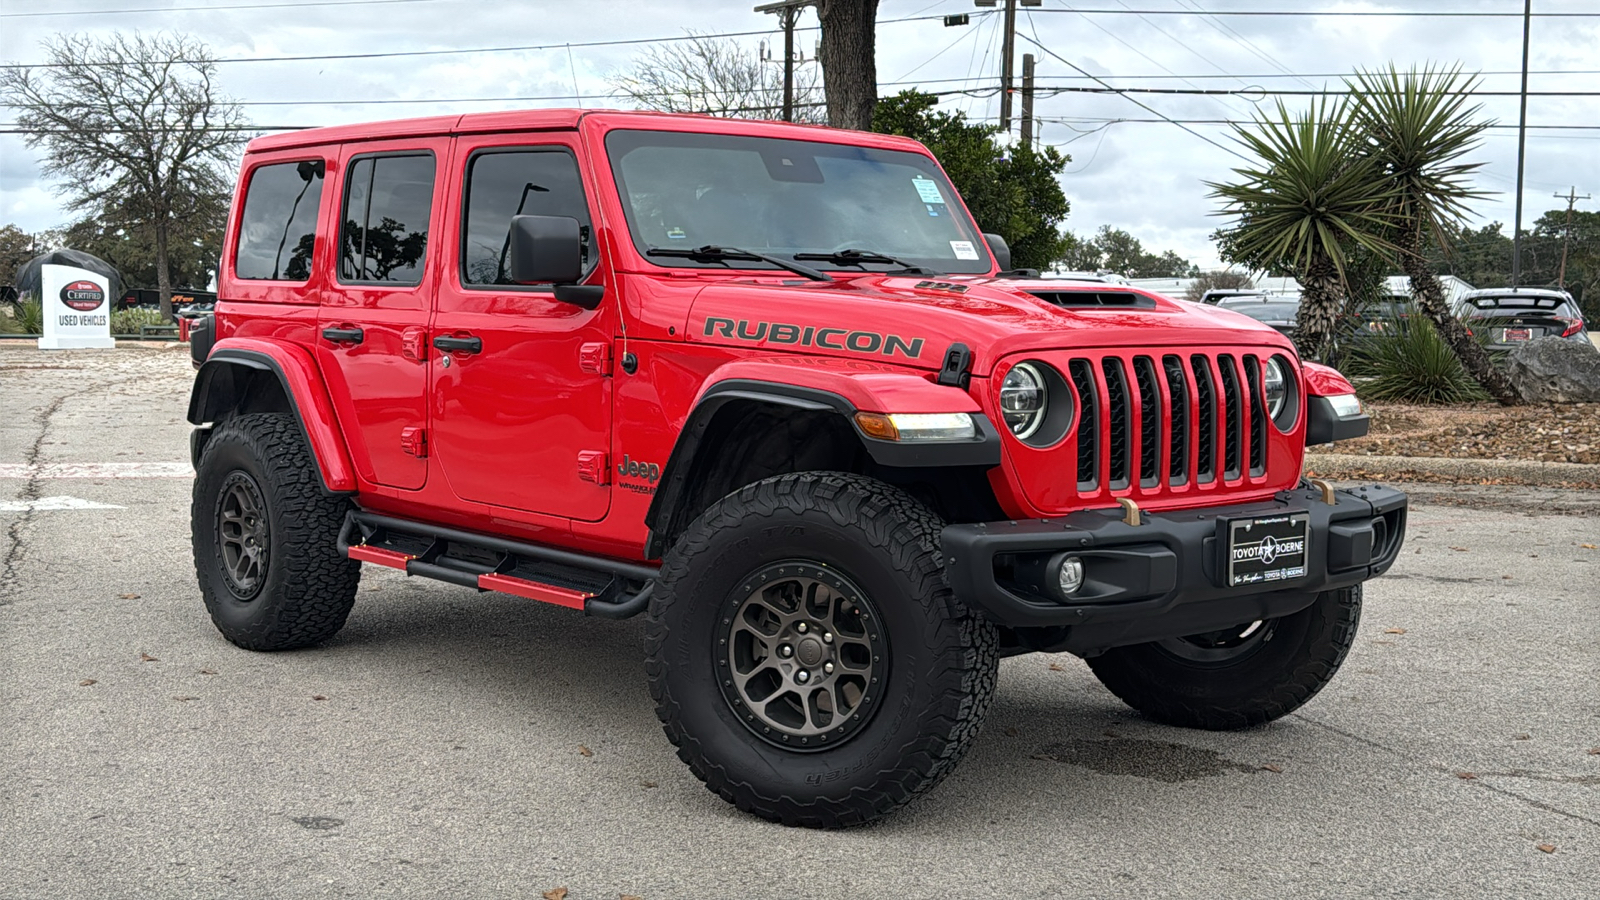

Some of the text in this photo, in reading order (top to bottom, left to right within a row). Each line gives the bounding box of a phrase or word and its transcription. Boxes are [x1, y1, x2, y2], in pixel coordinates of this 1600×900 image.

[67, 290, 102, 300] CERTIFIED
[59, 315, 106, 326] USED VEHICLES
[702, 316, 925, 359] RUBICON
[617, 453, 660, 484] Jeep
[1233, 541, 1303, 558] TOYOTA BOERNE
